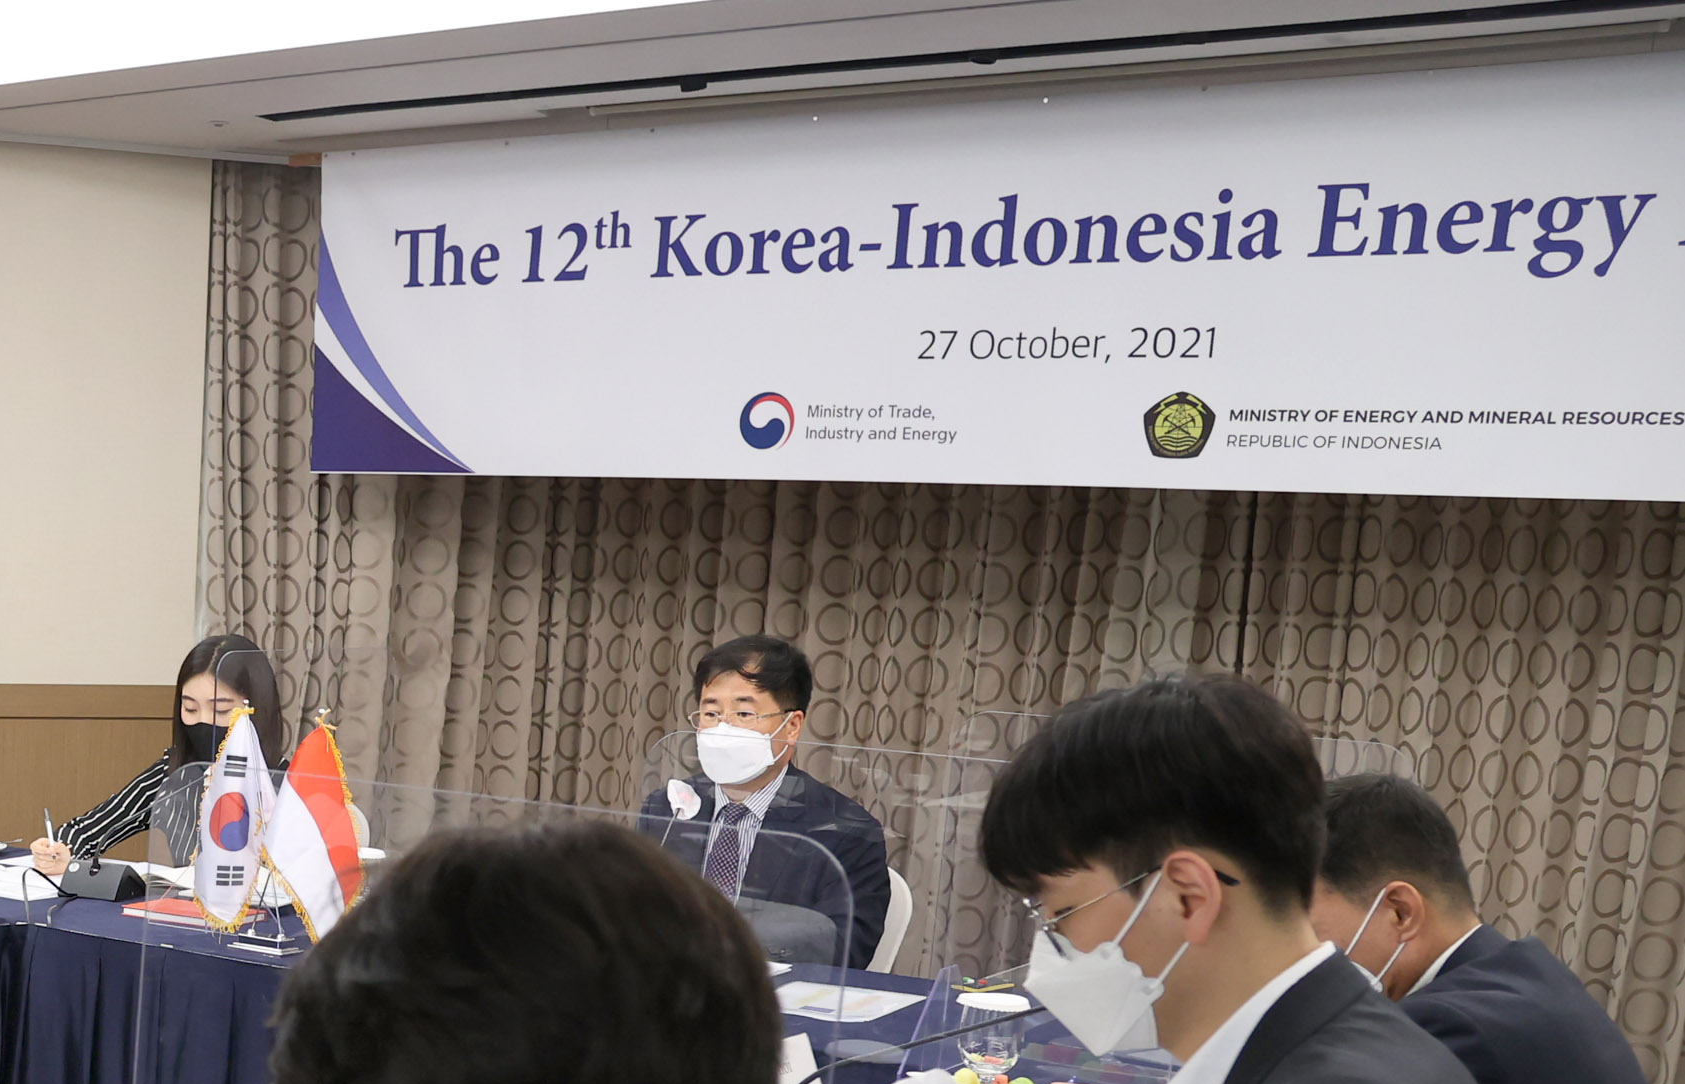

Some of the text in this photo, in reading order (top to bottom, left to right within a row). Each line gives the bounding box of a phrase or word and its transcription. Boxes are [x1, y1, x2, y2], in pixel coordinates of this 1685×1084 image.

[394, 182, 1658, 288] The 12th Korea-Indonesia Energy
[917, 326, 1216, 364] 27 October, 2021
[806, 404, 936, 422] Ministry of Trade,
[1228, 408, 1685, 426] MINISTRY OF ENERGY AND MINERAL RESOURCES
[805, 425, 958, 445] Industry and Energy
[1226, 433, 1443, 451] REPUBLIC OF INDONESIA
